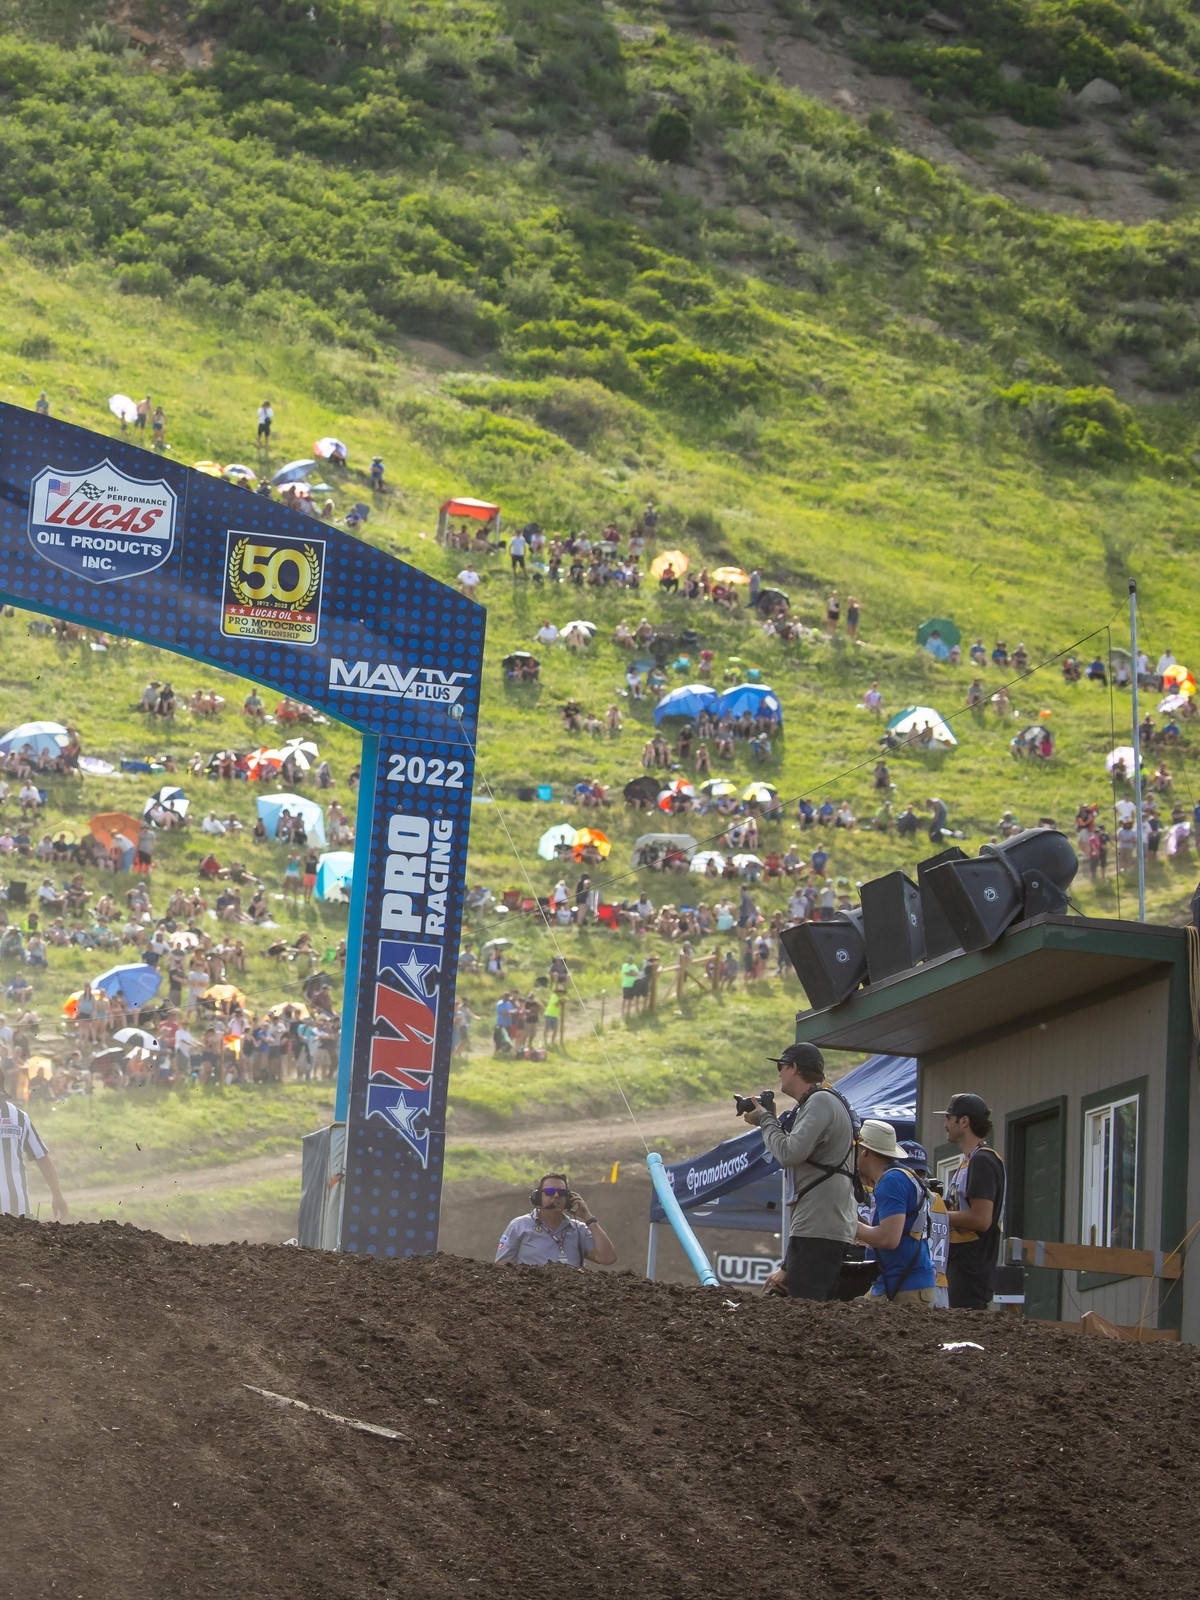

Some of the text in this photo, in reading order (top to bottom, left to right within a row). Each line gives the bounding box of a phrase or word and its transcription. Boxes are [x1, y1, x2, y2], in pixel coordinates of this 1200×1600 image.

[106, 493, 168, 506] PERFORMANCE
[44, 499, 164, 534] LUCAS
[36, 531, 163, 557] OIL PRODUCTS
[239, 544, 312, 603] 50
[228, 616, 313, 633] PRO MOTOCROSS
[250, 608, 292, 620] LUCAS OIL
[239, 626, 301, 639] CHAMPIONSHIP
[415, 684, 451, 701] PLUS
[386, 753, 465, 789] 2022
[380, 813, 431, 934] PRO
[424, 818, 454, 936] RACING
[686, 1151, 749, 1196] @promotocross
